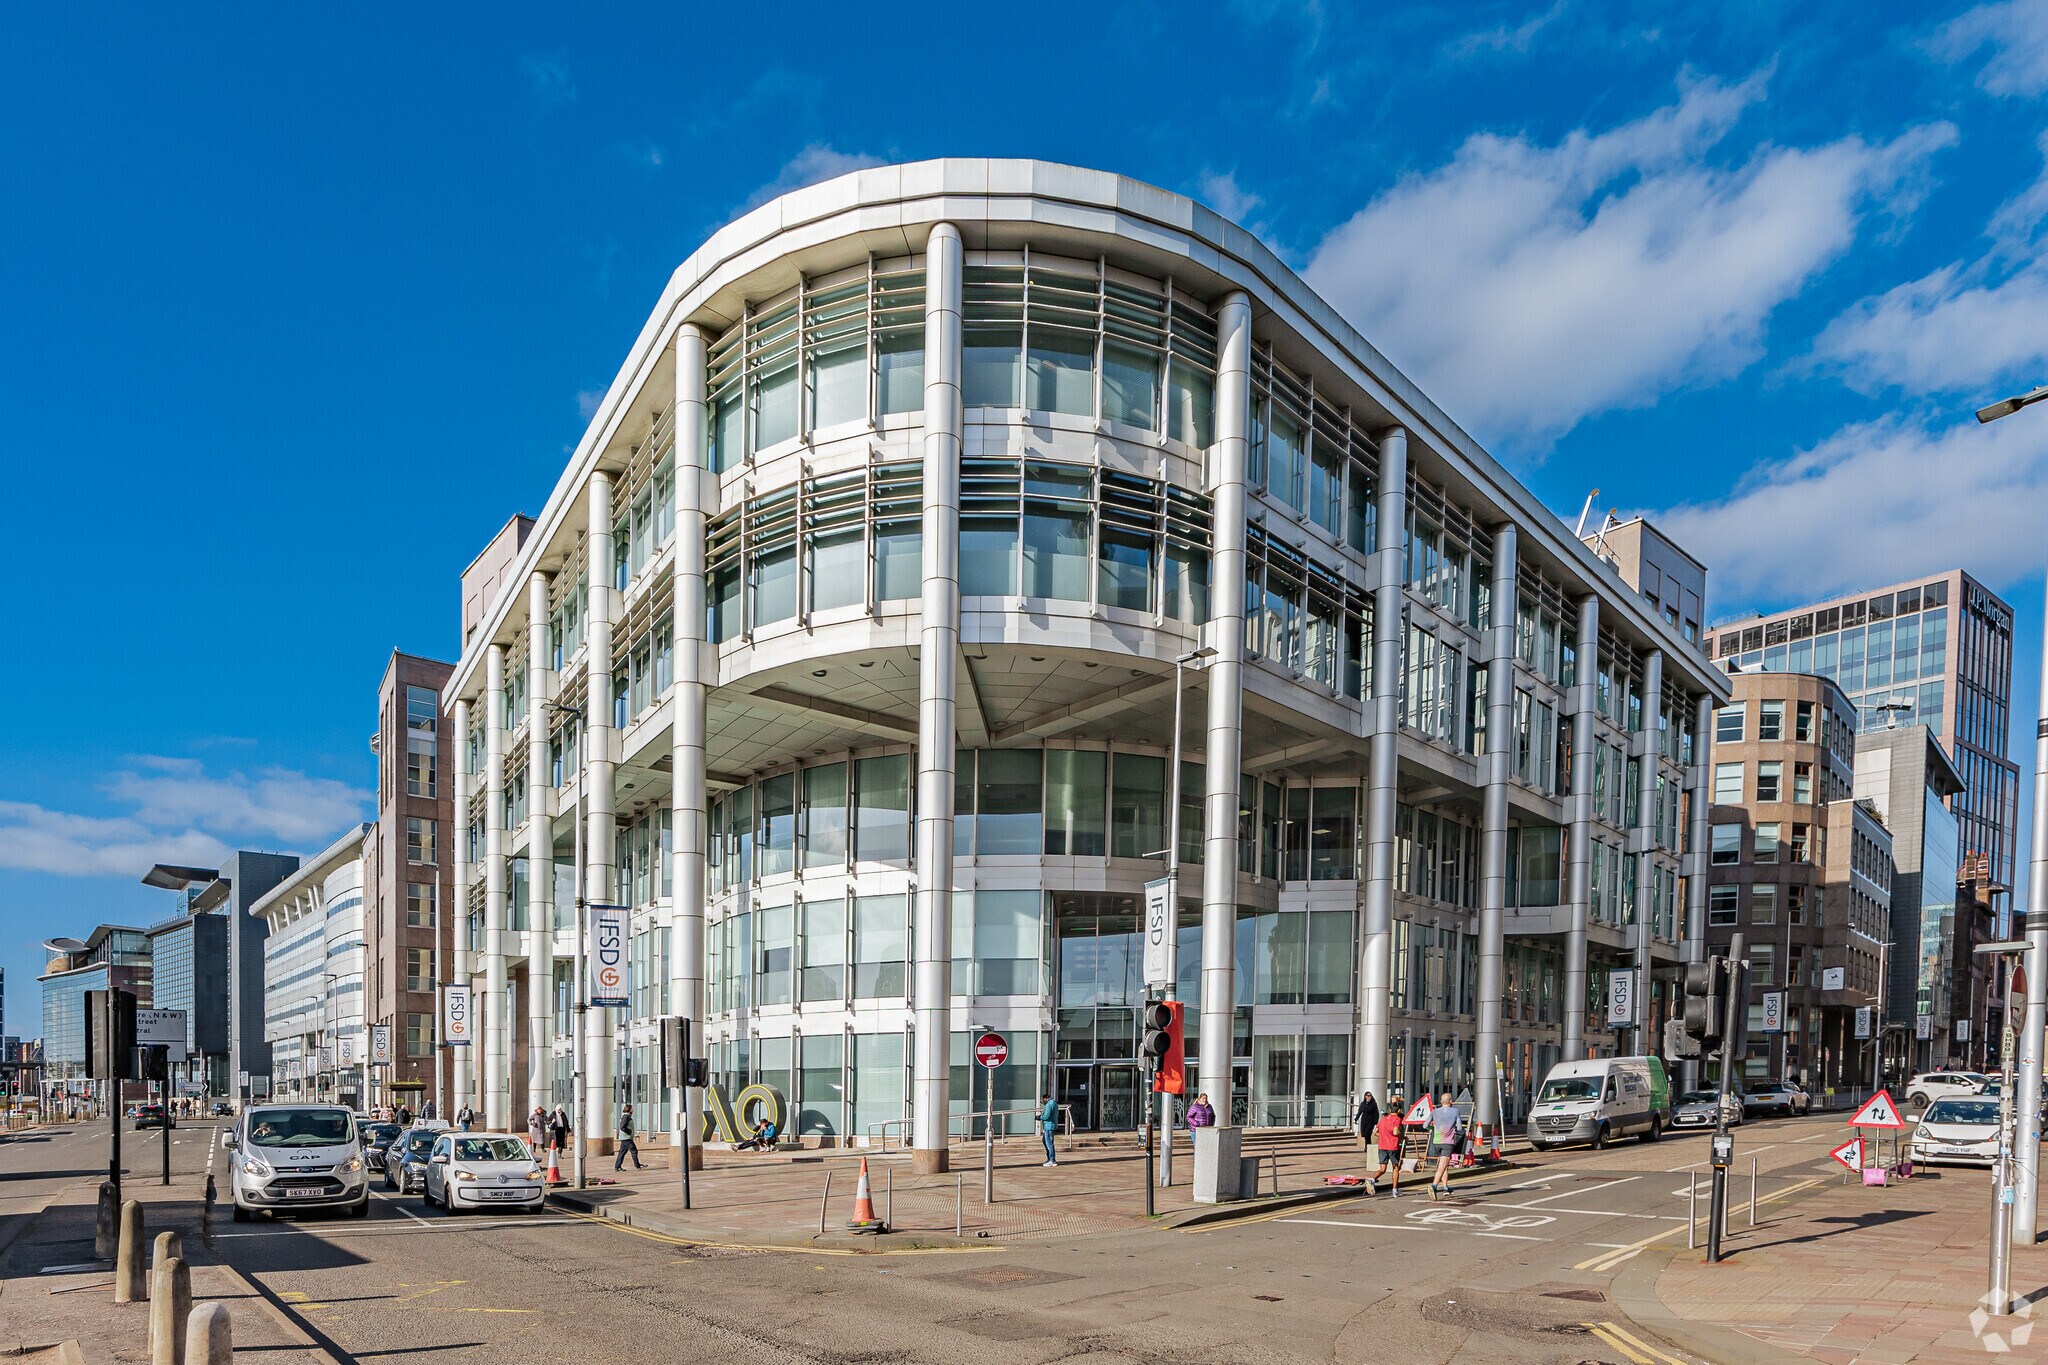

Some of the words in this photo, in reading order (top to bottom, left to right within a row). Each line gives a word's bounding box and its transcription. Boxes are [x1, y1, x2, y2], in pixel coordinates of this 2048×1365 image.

[1151, 896, 1163, 946] IFSD
[599, 918, 620, 966] IFSD
[1614, 977, 1627, 1004] IFSD
[451, 992, 464, 1021] IFSD
[1767, 996, 1777, 1017] IFSD
[376, 1029, 386, 1050] IFSD
